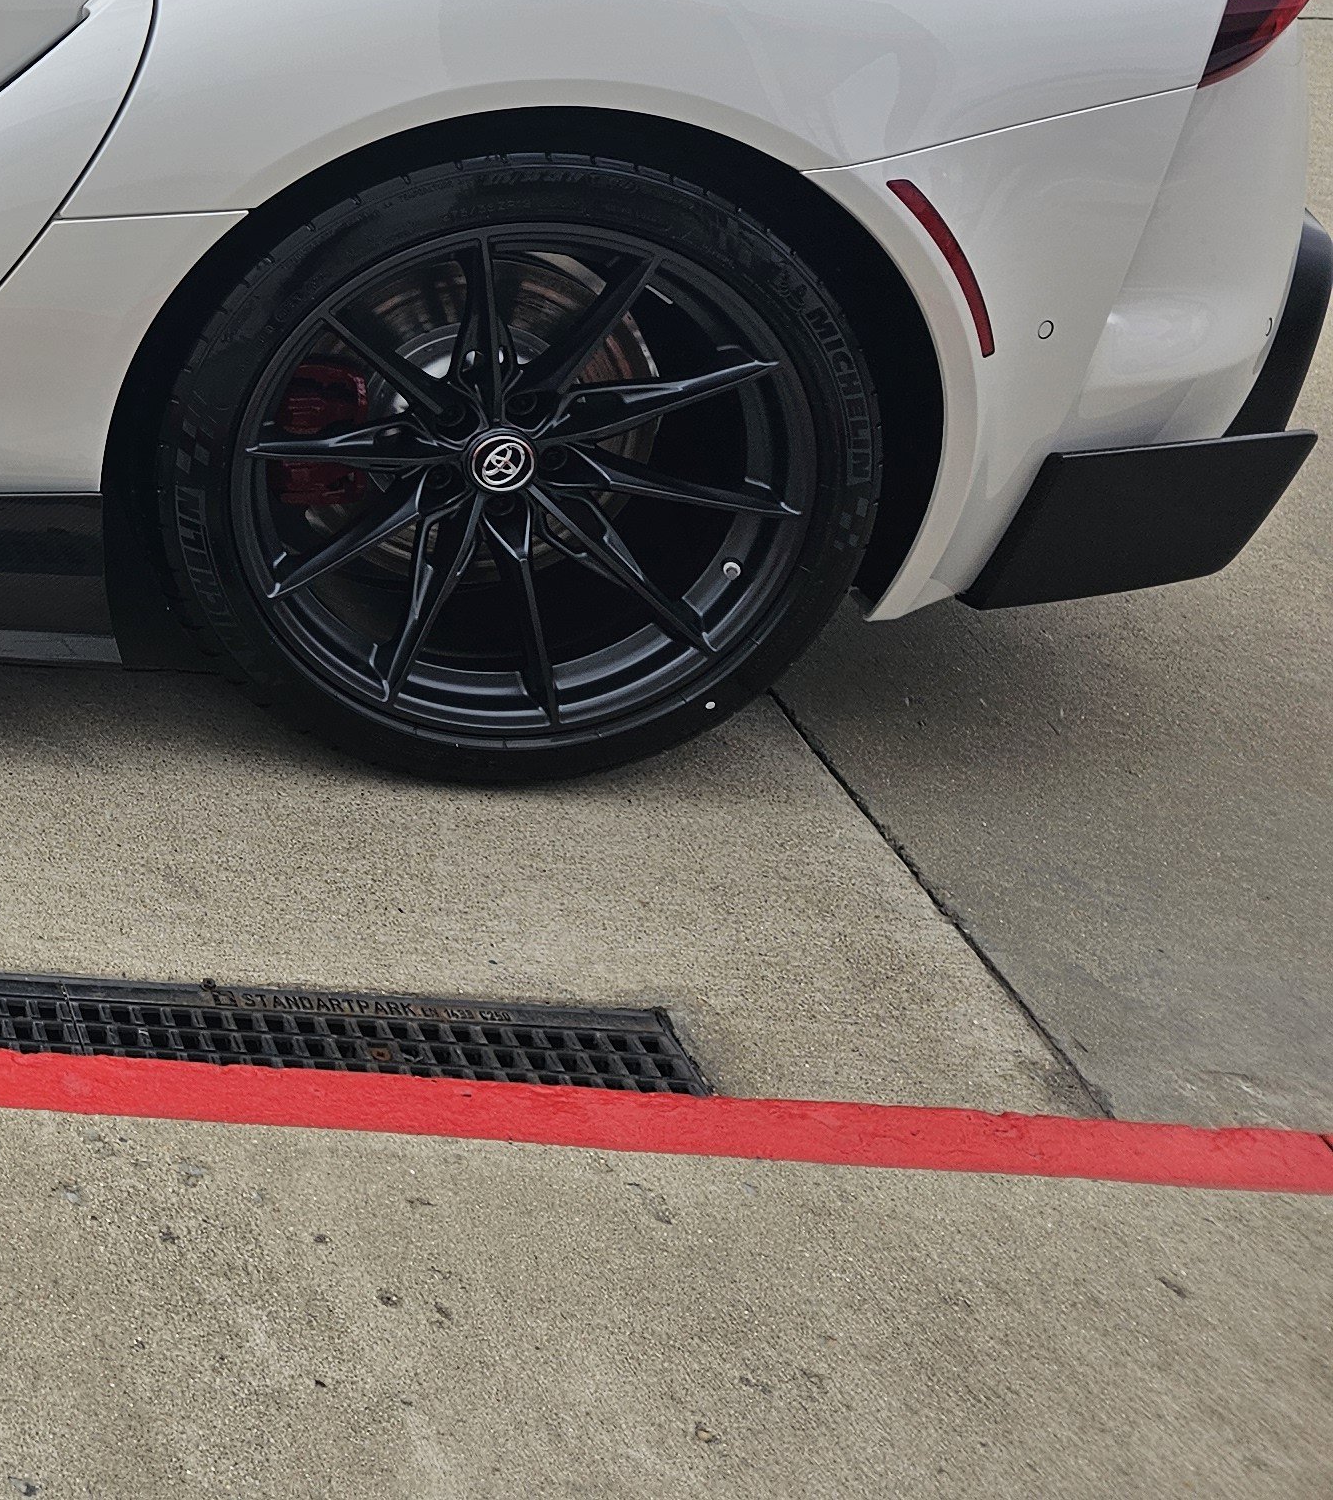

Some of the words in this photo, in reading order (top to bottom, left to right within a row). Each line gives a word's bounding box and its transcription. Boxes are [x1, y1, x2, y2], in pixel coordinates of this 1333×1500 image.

[804, 306, 873, 483] MICHELIN
[242, 993, 416, 1017] STANDARTPARK
[478, 1009, 511, 1022] C250
